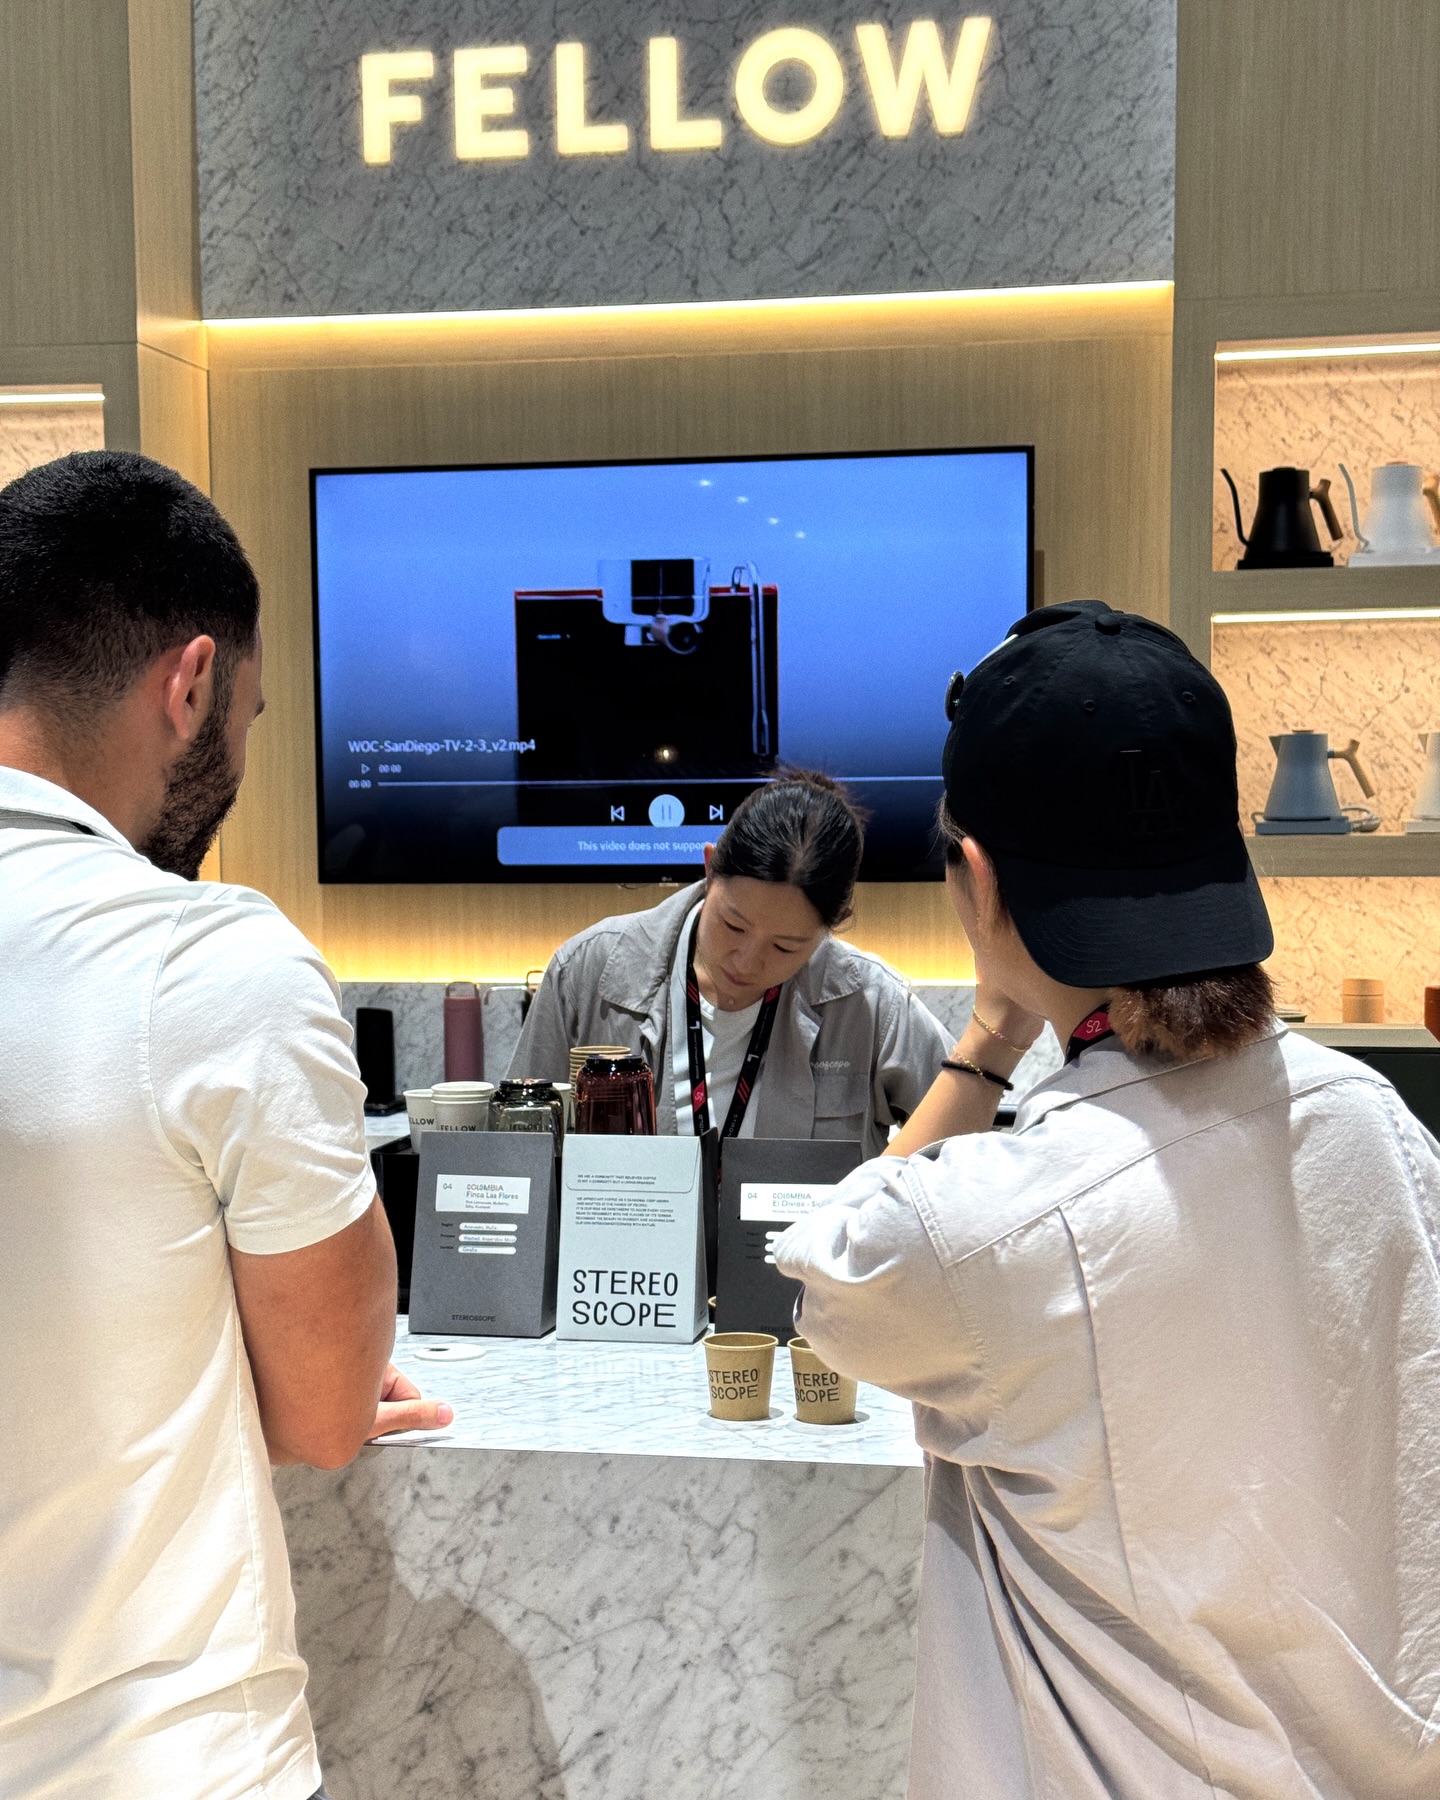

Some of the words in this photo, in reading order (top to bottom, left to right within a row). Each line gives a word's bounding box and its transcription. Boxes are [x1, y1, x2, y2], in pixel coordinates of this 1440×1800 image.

[360, 16, 992, 165] FELLOW
[578, 841, 598, 851] This
[600, 841, 627, 851] video
[628, 841, 651, 851] does
[653, 841, 670, 851] not
[1086, 1020, 1102, 1034] S2
[442, 1182, 453, 1190] 04
[466, 1184, 504, 1192] COLOMBIA
[466, 1190, 485, 1199] Finca
[486, 1191, 497, 1199] Las
[498, 1191, 519, 1200] Flores
[573, 1269, 679, 1297] STEREO
[572, 1300, 677, 1328] SCOPE
[708, 1368, 758, 1384] STEREO
[794, 1372, 839, 1387] TEREO
[711, 1384, 758, 1400] SCOPE
